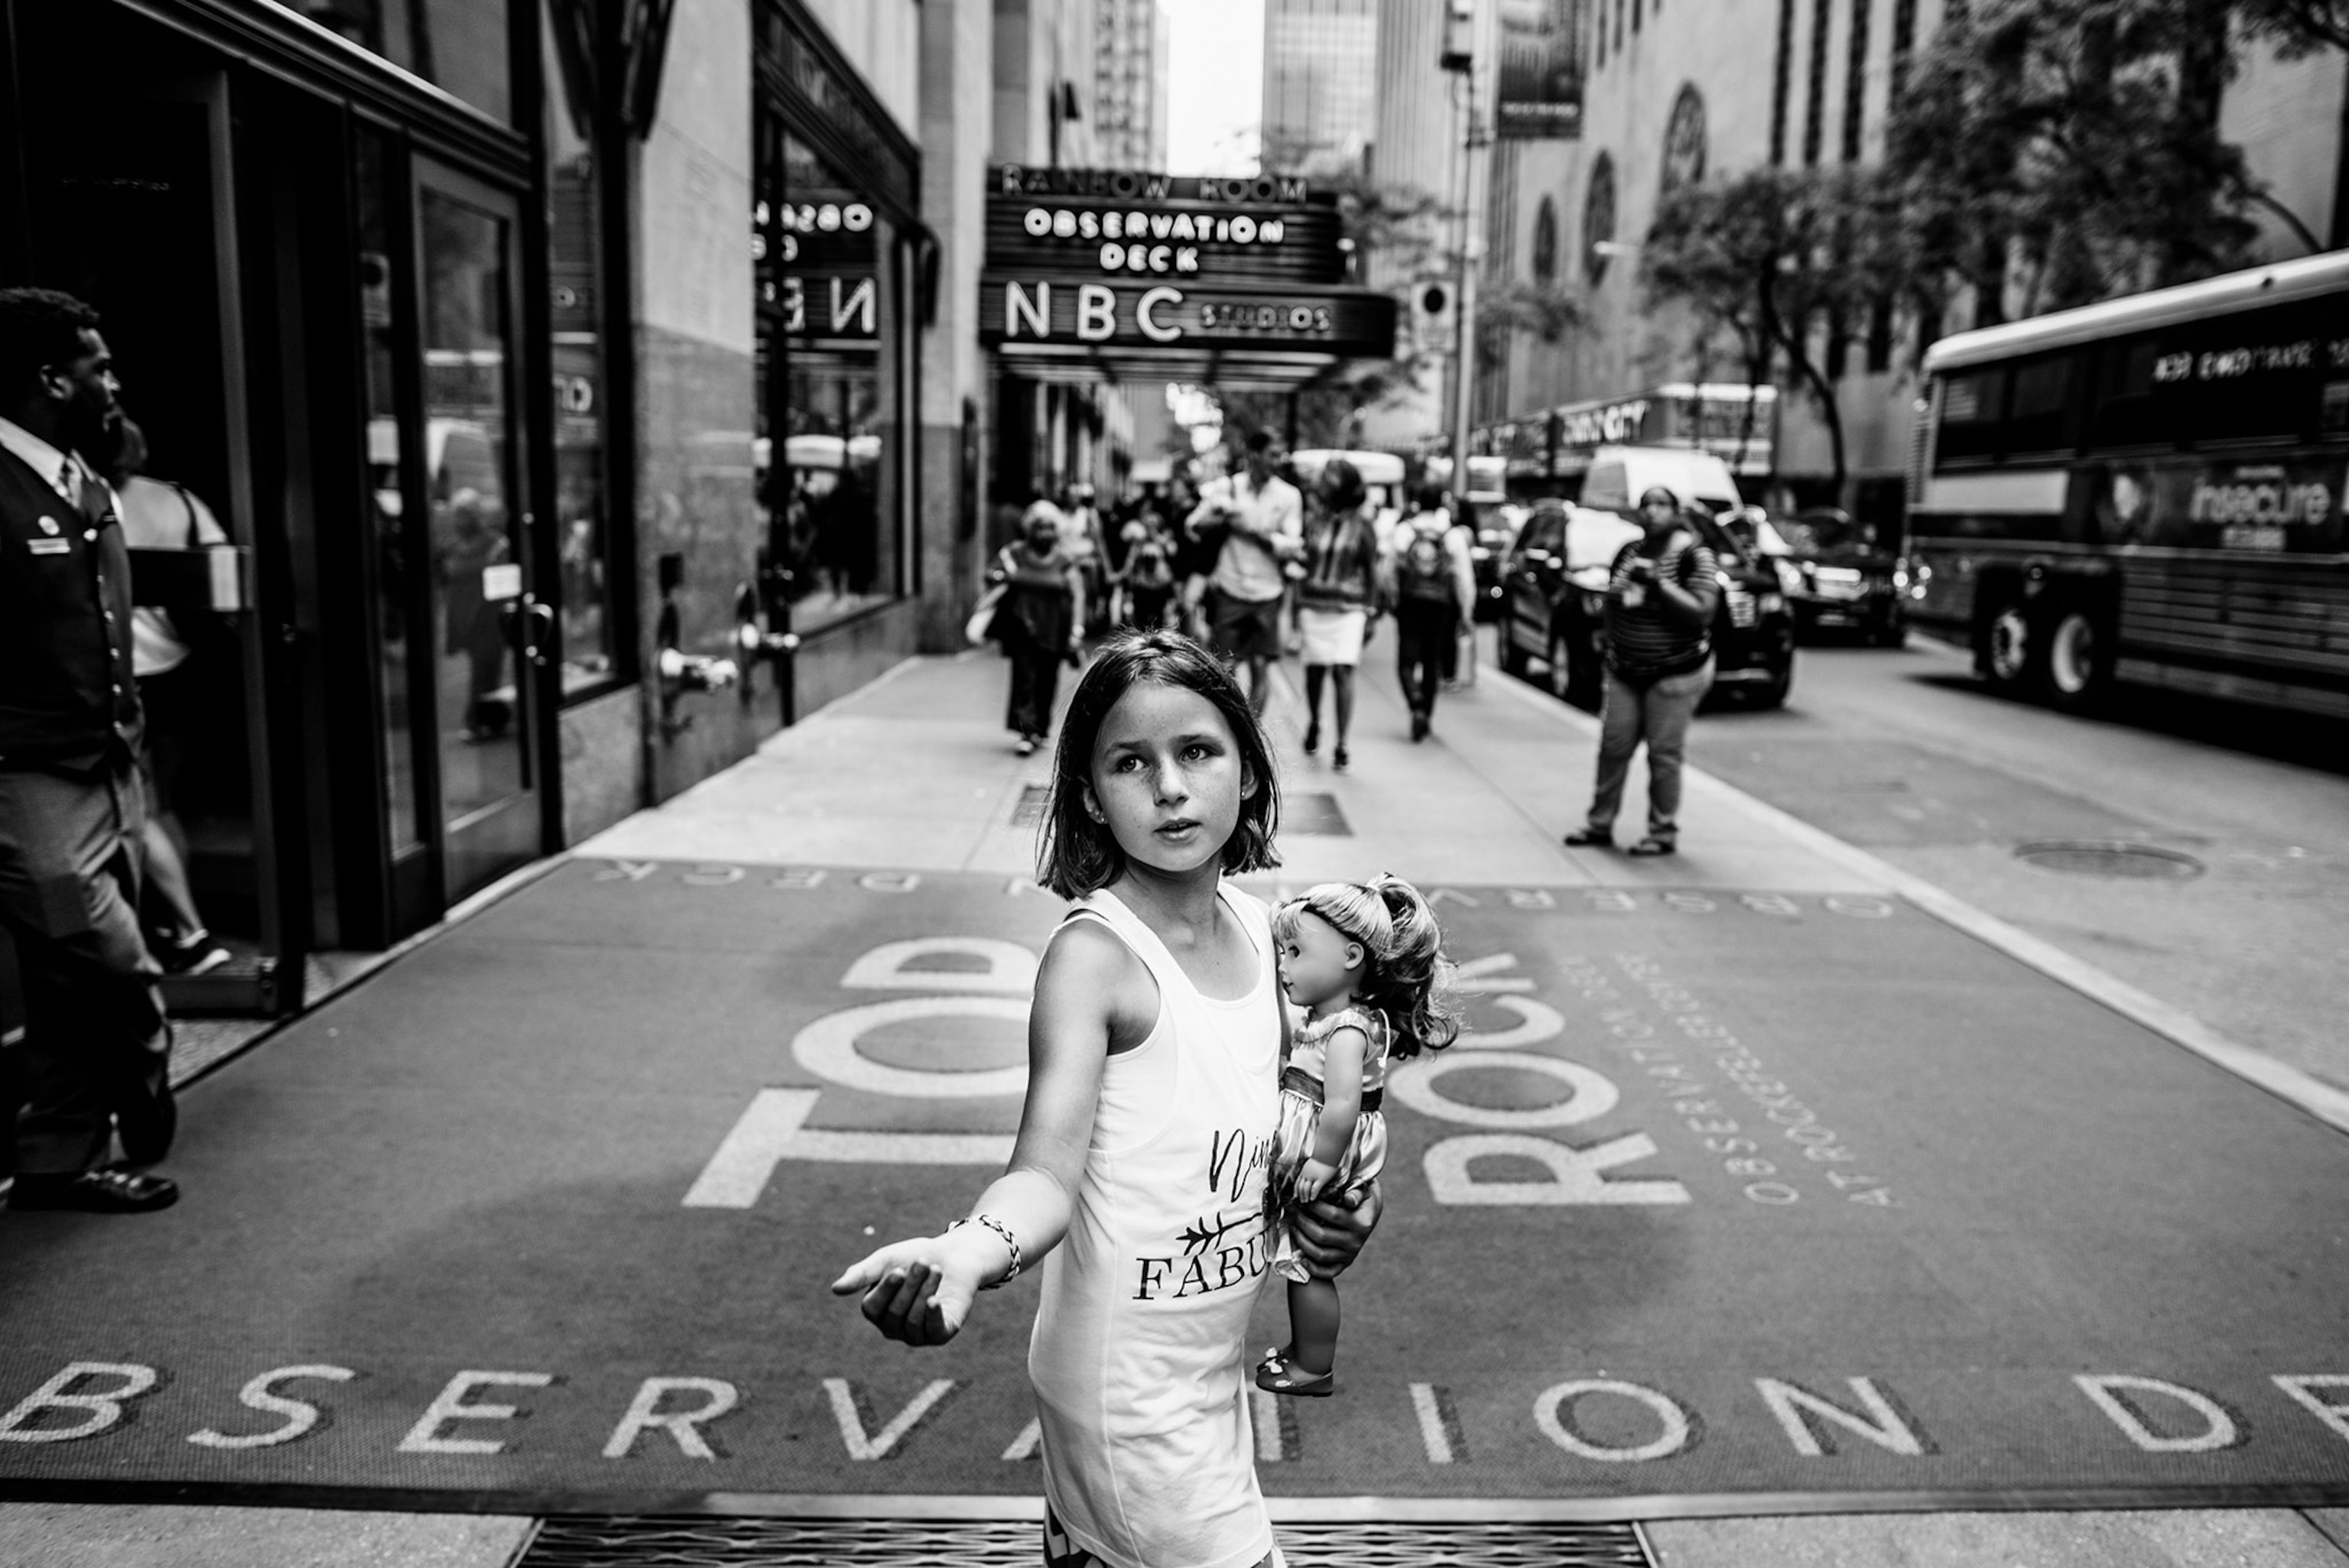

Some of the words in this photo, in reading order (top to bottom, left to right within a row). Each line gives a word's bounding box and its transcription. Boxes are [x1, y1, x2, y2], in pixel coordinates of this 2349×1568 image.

[1200, 175, 1307, 203] ROOM
[1024, 207, 1285, 244] OBSERVATION
[1100, 242, 1199, 273] DECK
[1005, 280, 1184, 342] NBC
[1200, 303, 1331, 333] STUDIOS
